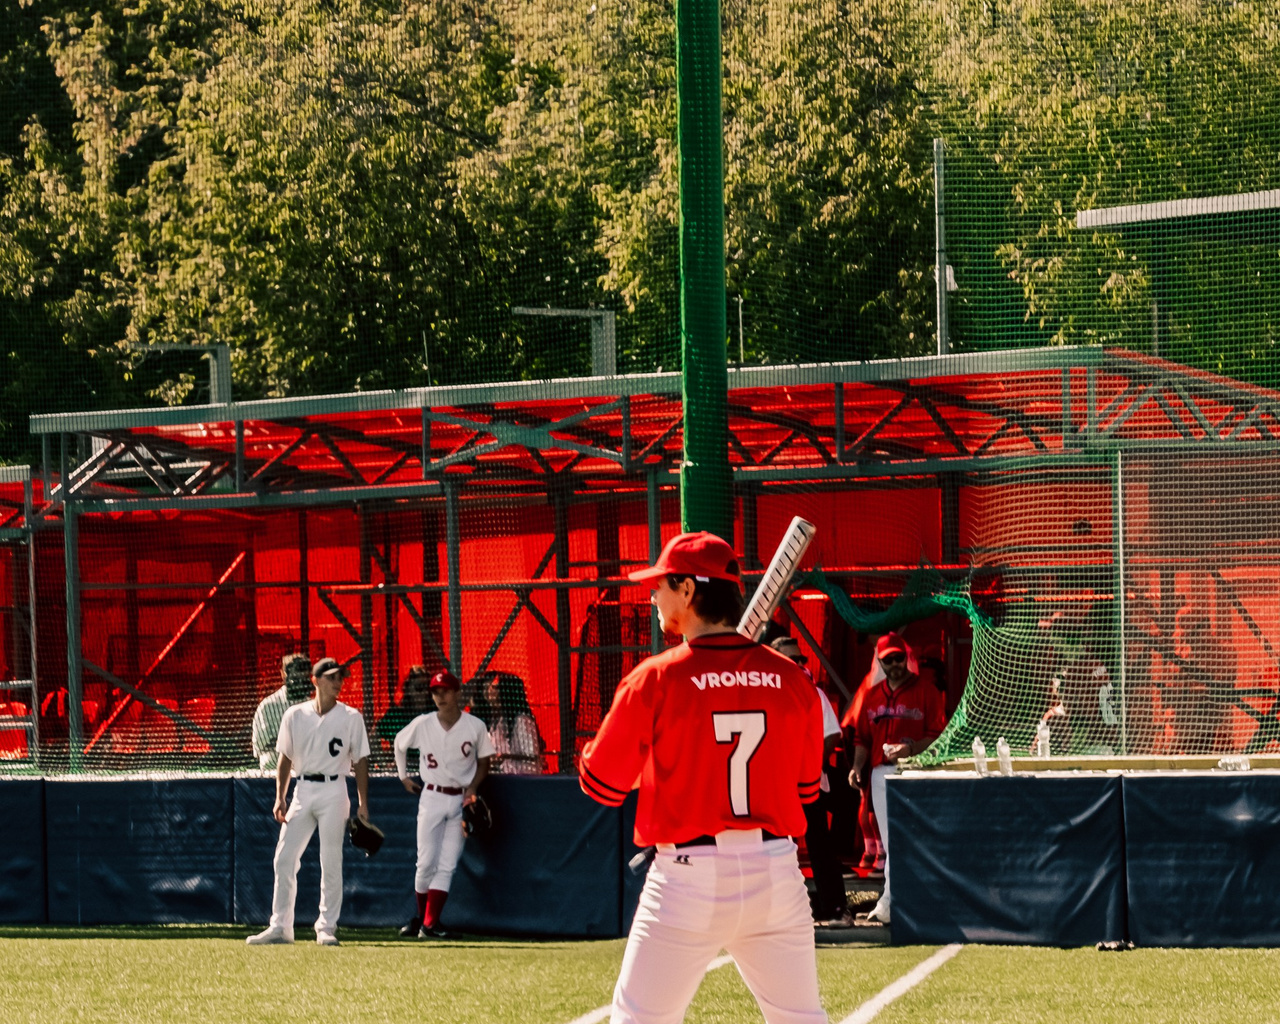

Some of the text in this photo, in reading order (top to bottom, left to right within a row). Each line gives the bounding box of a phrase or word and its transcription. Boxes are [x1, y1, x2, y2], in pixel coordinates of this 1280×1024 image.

[690, 670, 782, 691] VRONSKI
[328, 737, 343, 757] C
[461, 741, 473, 758] C
[711, 709, 767, 819] 7
